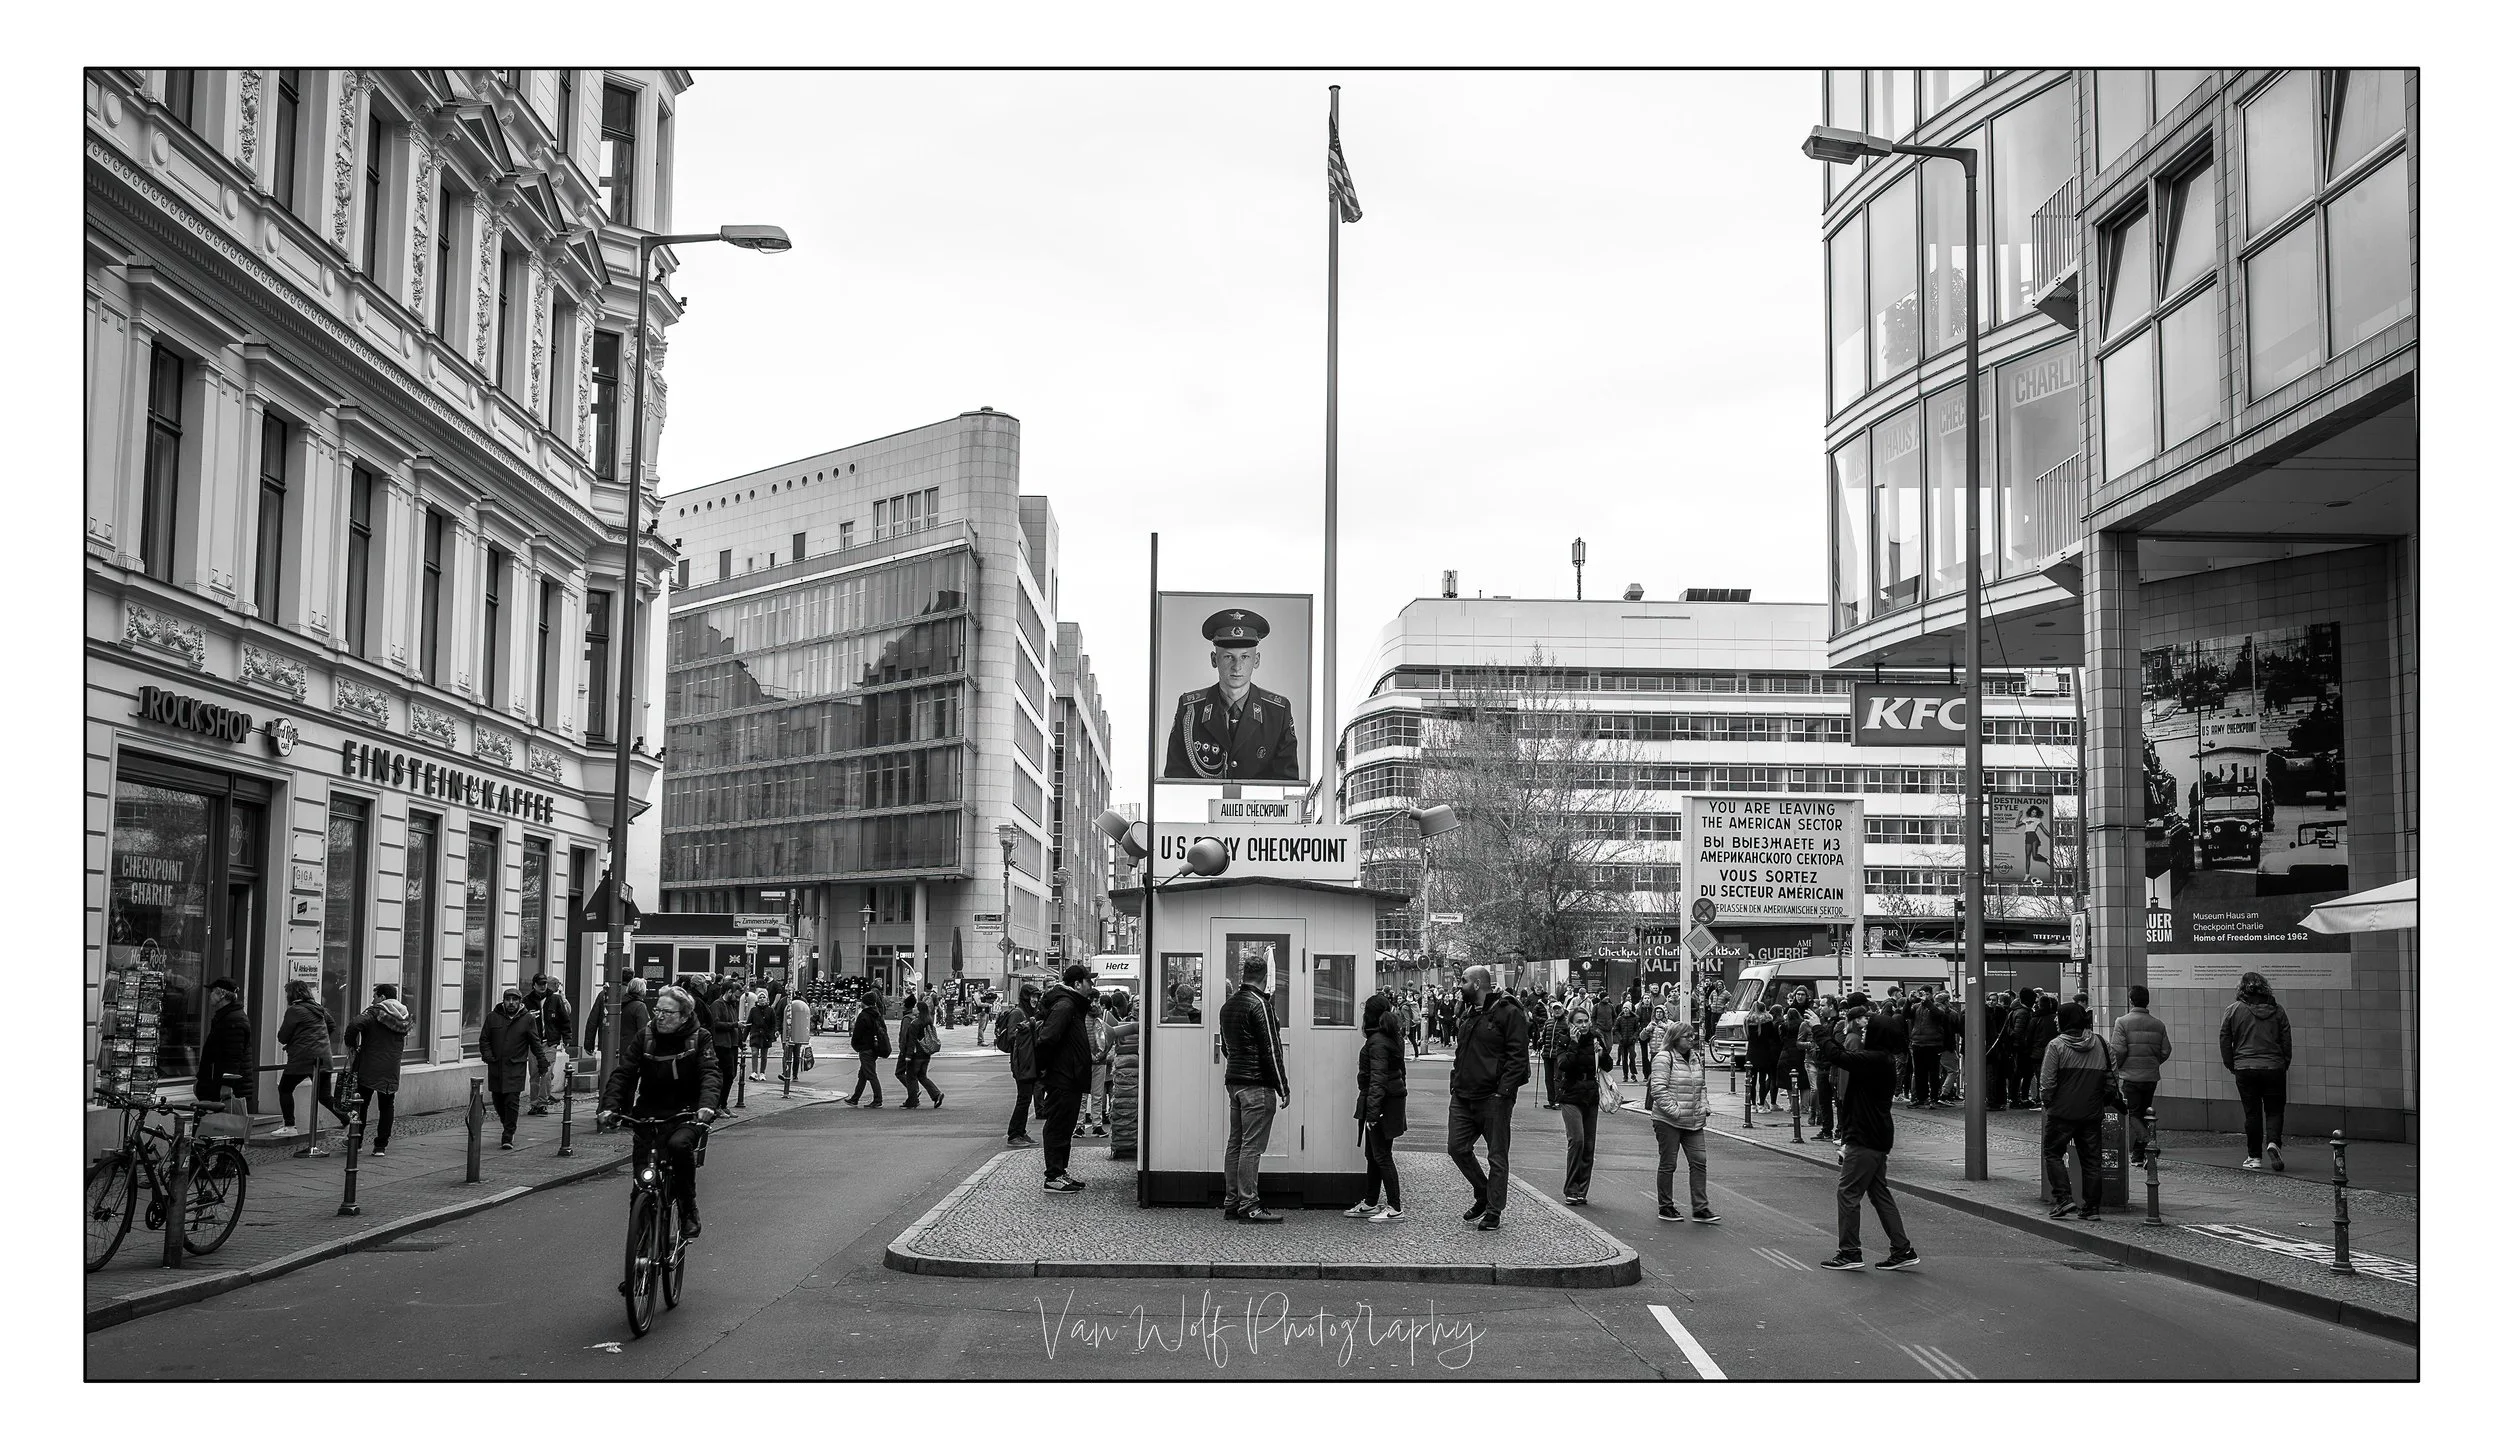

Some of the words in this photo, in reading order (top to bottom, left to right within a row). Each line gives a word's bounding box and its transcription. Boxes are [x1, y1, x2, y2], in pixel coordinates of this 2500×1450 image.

[2015, 354, 2077, 403] CHARLI
[147, 686, 204, 732] ROCK
[204, 703, 252, 743] SHOP
[1862, 697, 1966, 731] KFC
[343, 739, 464, 801] EINSTEIN
[482, 779, 554, 823] KAFFEE
[1709, 801, 1736, 814] YOU
[1744, 802, 1770, 814] ARE
[1779, 802, 1835, 815] LEAVING
[1993, 797, 2048, 805] DESTINATION
[1220, 803, 1244, 817] ALLIED
[1246, 803, 1289, 818] CHECKPOINT
[1702, 816, 1723, 829] THE
[1729, 817, 1791, 830] AMERICAN
[1798, 818, 1843, 831] SECTOR
[1247, 837, 1348, 863] CHECKPOINT
[1704, 836, 1724, 848] ВЫ
[1732, 837, 1814, 850] ВЫЕЗЖАЕТЕ
[1823, 838, 1841, 851] ИЗ
[1700, 851, 1792, 864] АМЕРИКАНСКОГО
[1797, 852, 1844, 865] СЕКТОРА
[122, 855, 184, 882] CHECKPOINT
[296, 870, 312, 881] GIGA
[1719, 869, 1757, 882] VOUS
[1765, 871, 1817, 884] SORTEZ
[131, 882, 173, 906] CHARLIE
[1700, 885, 1716, 897] DU
[1720, 885, 1774, 898] SECTEUR
[1778, 885, 1844, 900] AMÉRICAIN
[1749, 905, 1761, 914] DEN
[1763, 905, 1818, 915] AMERIKANISCHEN
[1819, 906, 1844, 916] SEKTOR
[2193, 912, 2224, 920] Museum
[2146, 913, 2172, 929] UER
[2193, 923, 2235, 932] Checkpoint
[2236, 922, 2264, 930] Charlie
[2146, 929, 2173, 943] SEUM
[2193, 933, 2216, 942] Home
[2217, 933, 2226, 941] of
[2227, 933, 2262, 942] Freedom
[2263, 932, 2286, 941] since
[2287, 932, 2308, 941] 1962
[1654, 945, 1680, 956] Charl
[1106, 962, 1130, 970] Hertz
